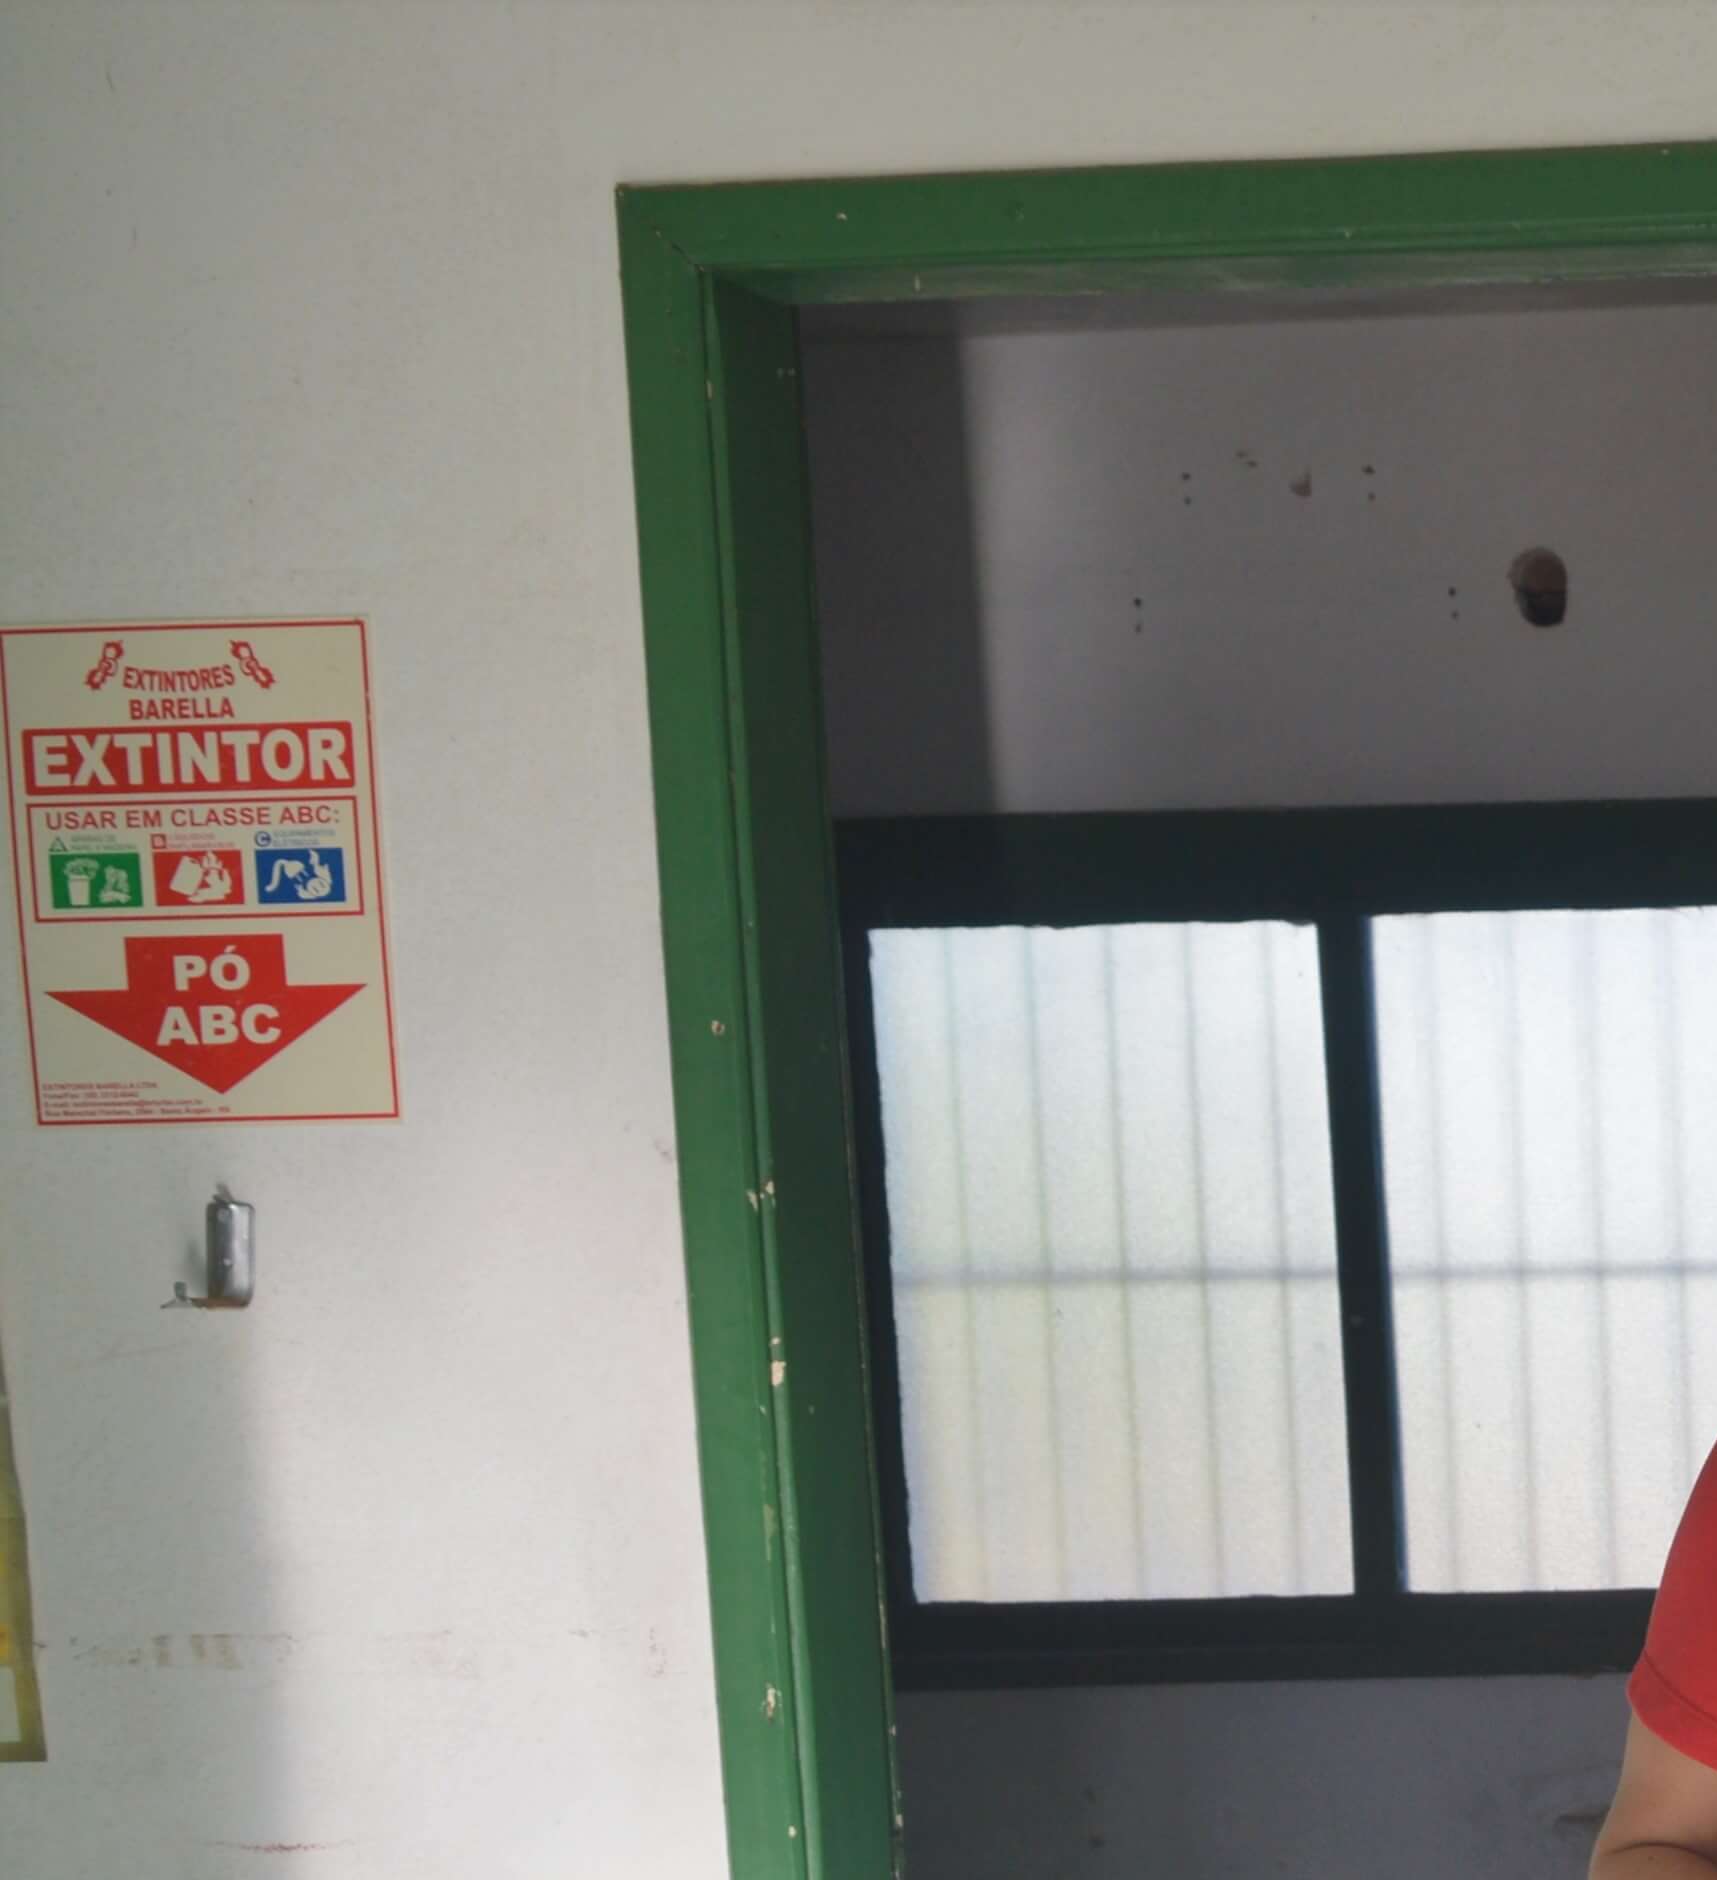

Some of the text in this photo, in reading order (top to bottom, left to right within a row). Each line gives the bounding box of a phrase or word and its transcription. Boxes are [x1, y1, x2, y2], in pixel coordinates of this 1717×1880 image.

[122, 664, 235, 692] EXTINTORES
[129, 697, 235, 721] BARELLA
[32, 729, 350, 788] EXTINTOR
[45, 804, 341, 831] USAR EM CLASSE ABC:
[172, 945, 251, 991] PÓ
[156, 1004, 281, 1047] ABC
